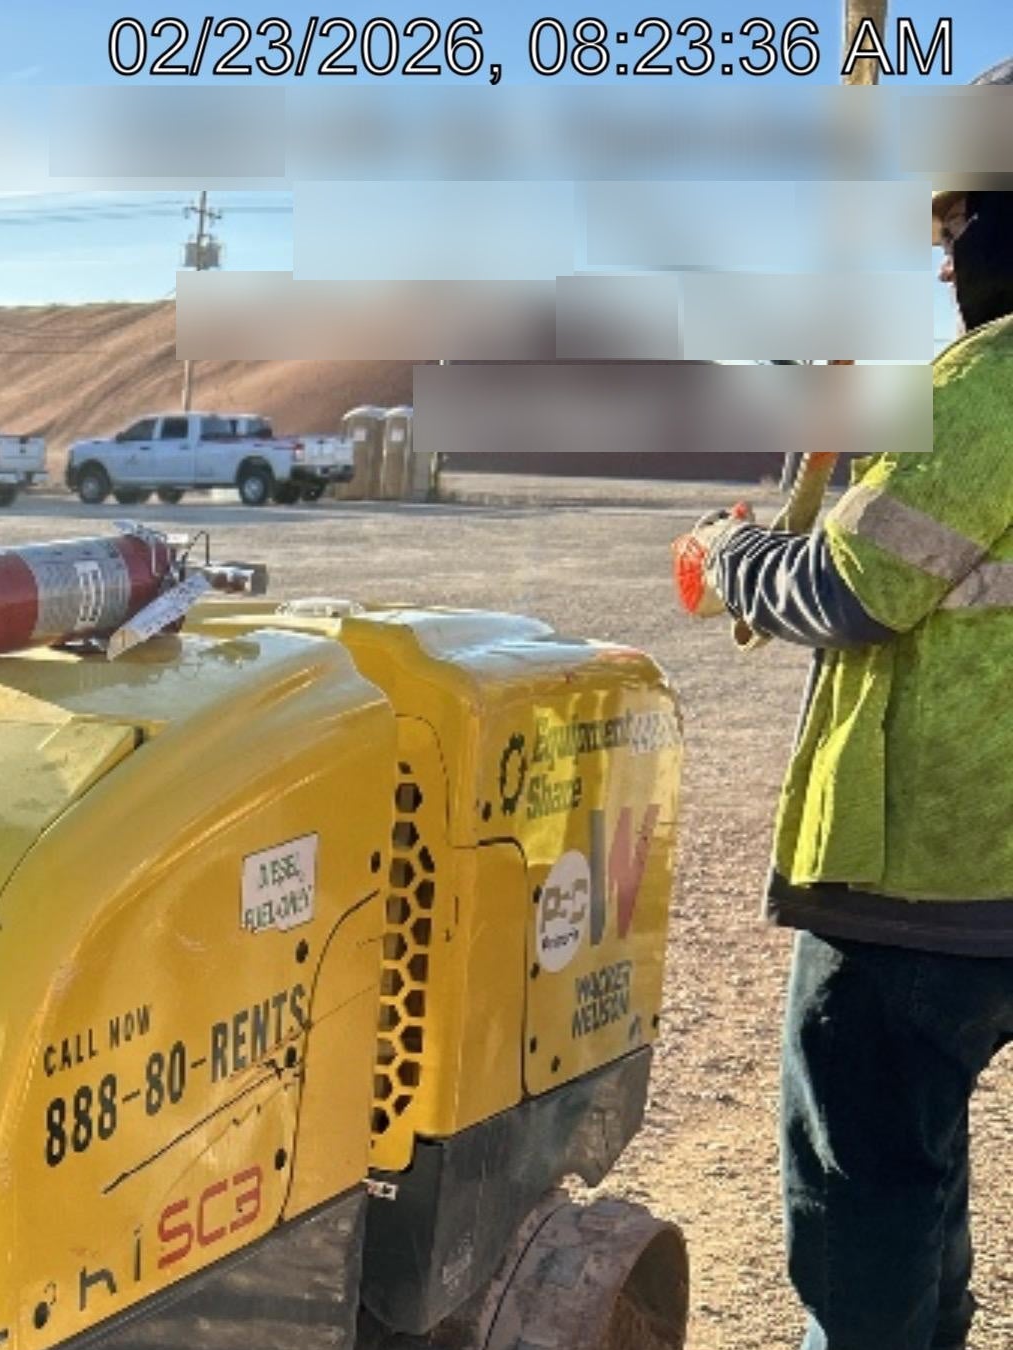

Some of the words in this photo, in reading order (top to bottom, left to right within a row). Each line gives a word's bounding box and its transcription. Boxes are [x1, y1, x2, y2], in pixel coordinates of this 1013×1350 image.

[43, 1028, 99, 1077] CALL
[109, 1004, 152, 1051] NOW
[44, 982, 313, 1169] 888-80-RENTS
